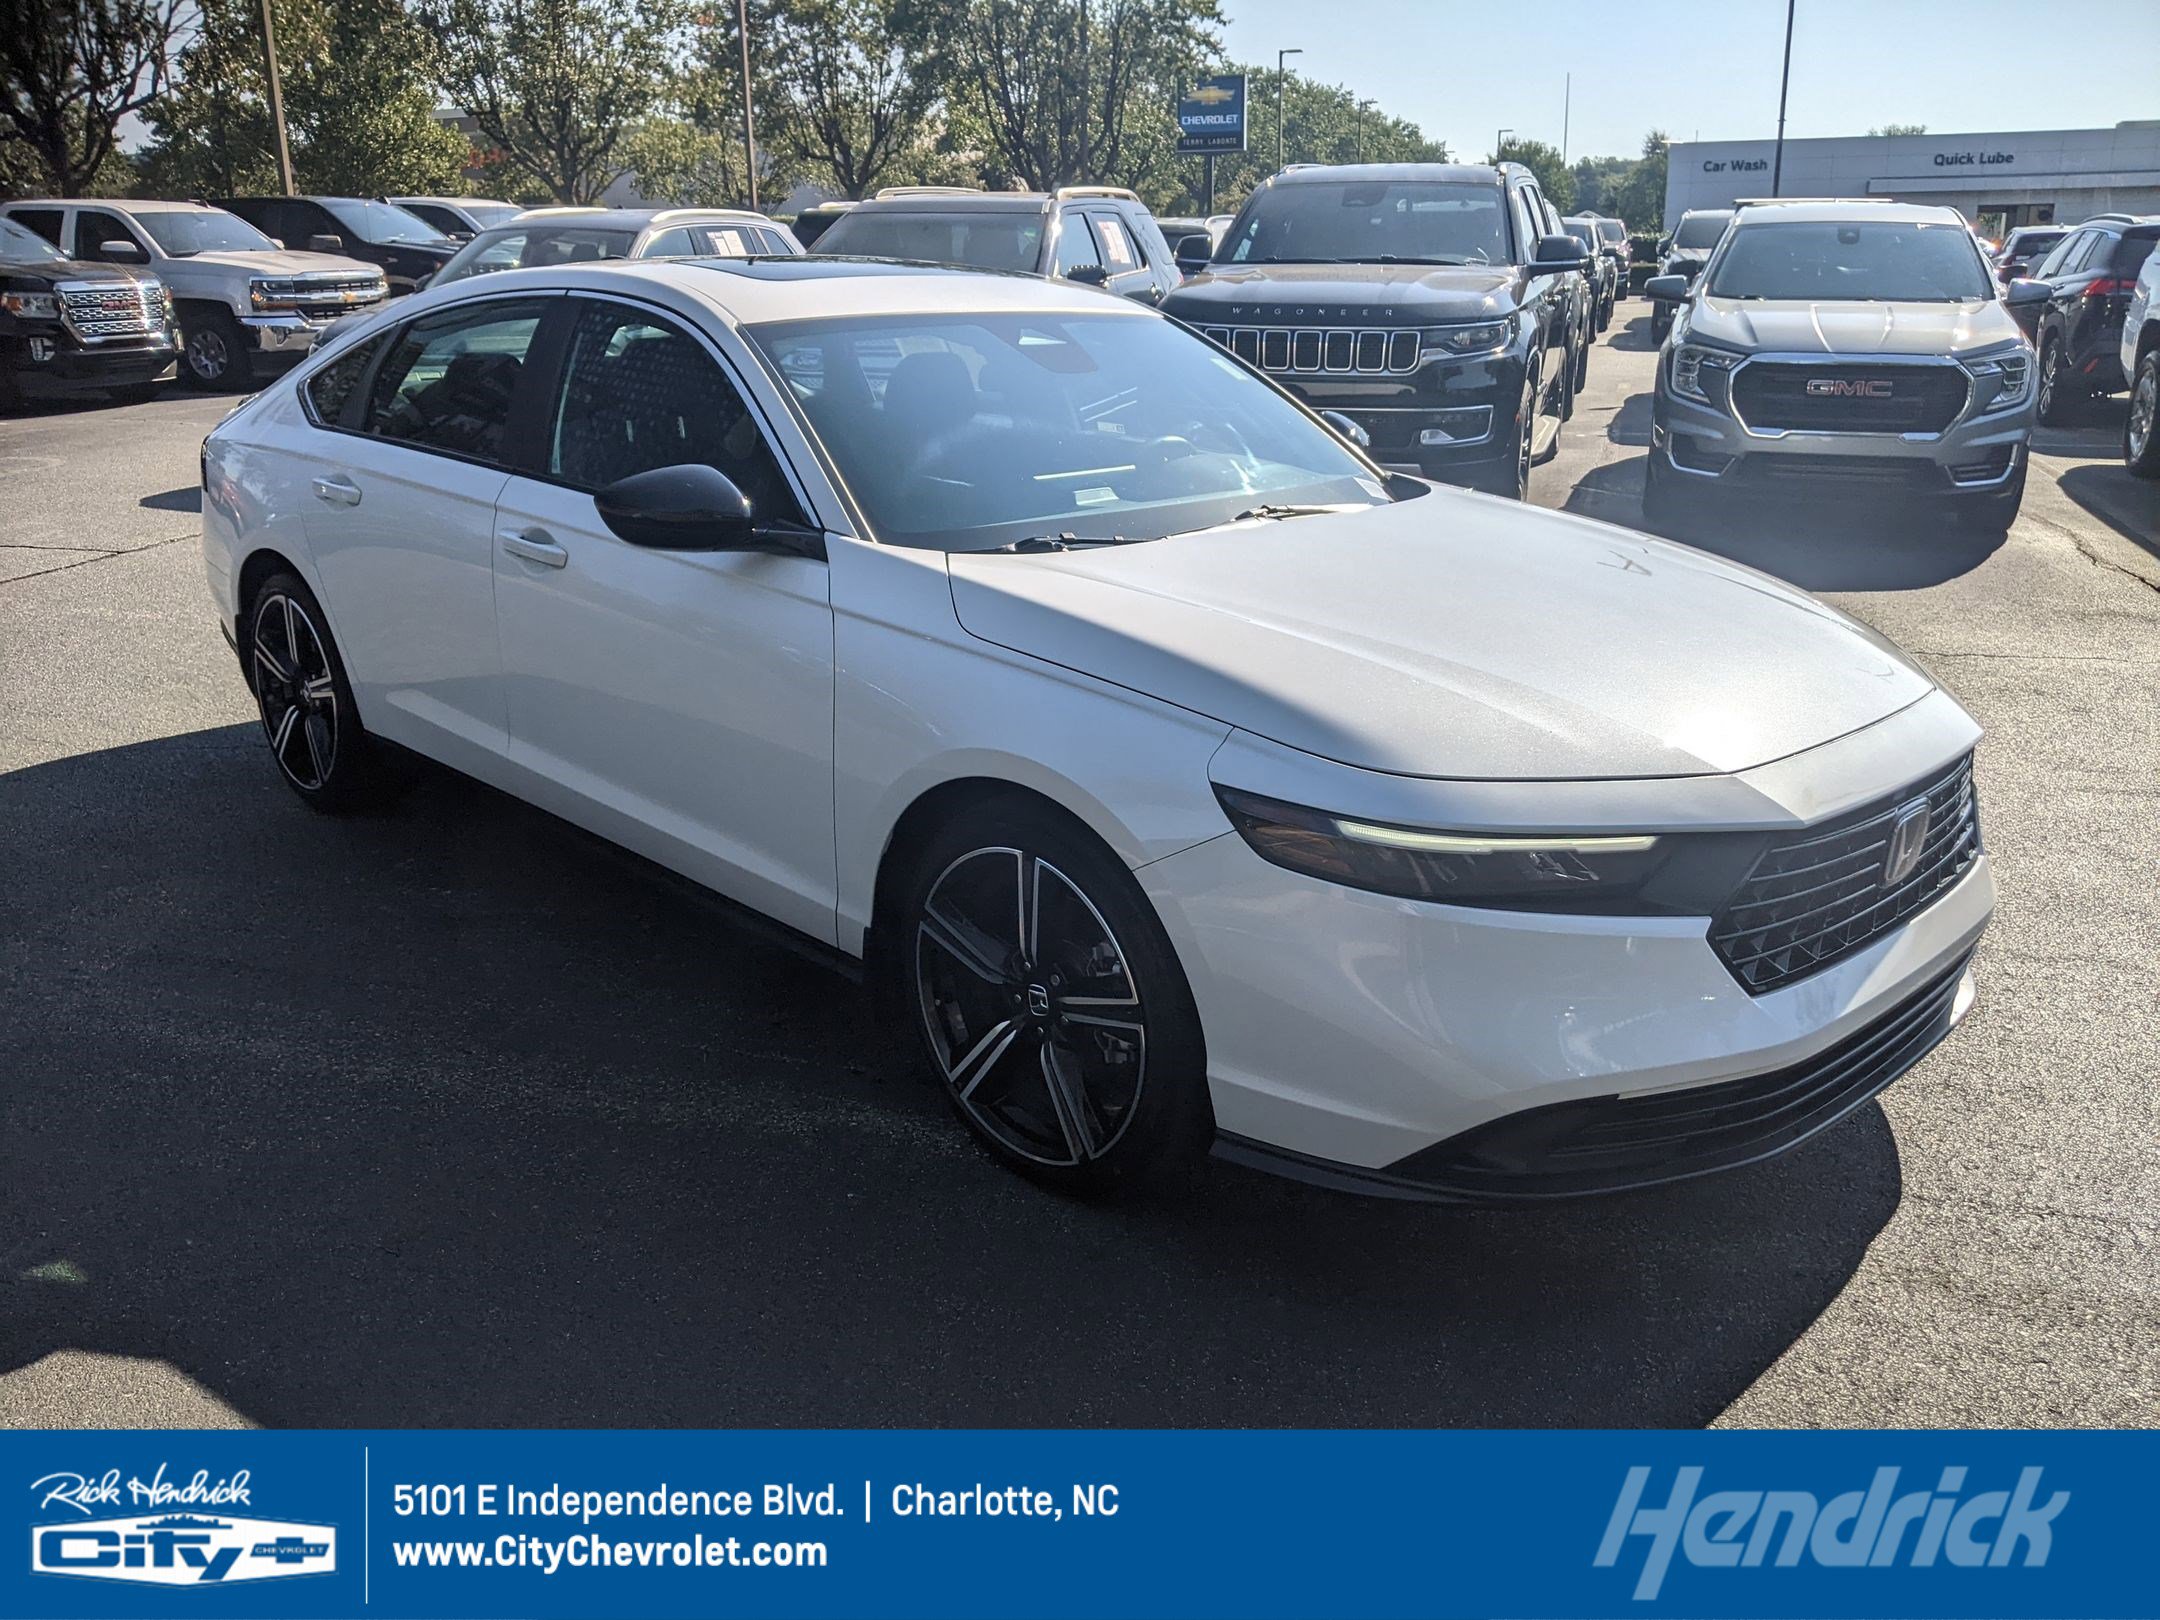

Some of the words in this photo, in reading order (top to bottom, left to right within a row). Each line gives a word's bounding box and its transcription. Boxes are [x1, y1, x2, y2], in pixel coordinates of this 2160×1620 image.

[1181, 114, 1239, 126] CHEVROLET
[1933, 153, 1975, 167] Quick
[1979, 152, 2015, 165] Lube
[1703, 161, 1727, 173] Car
[1730, 160, 1768, 172] Wash
[101, 300, 139, 311] GMC
[1231, 306, 1393, 317] WAGONEER
[1806, 379, 1893, 397] GMC
